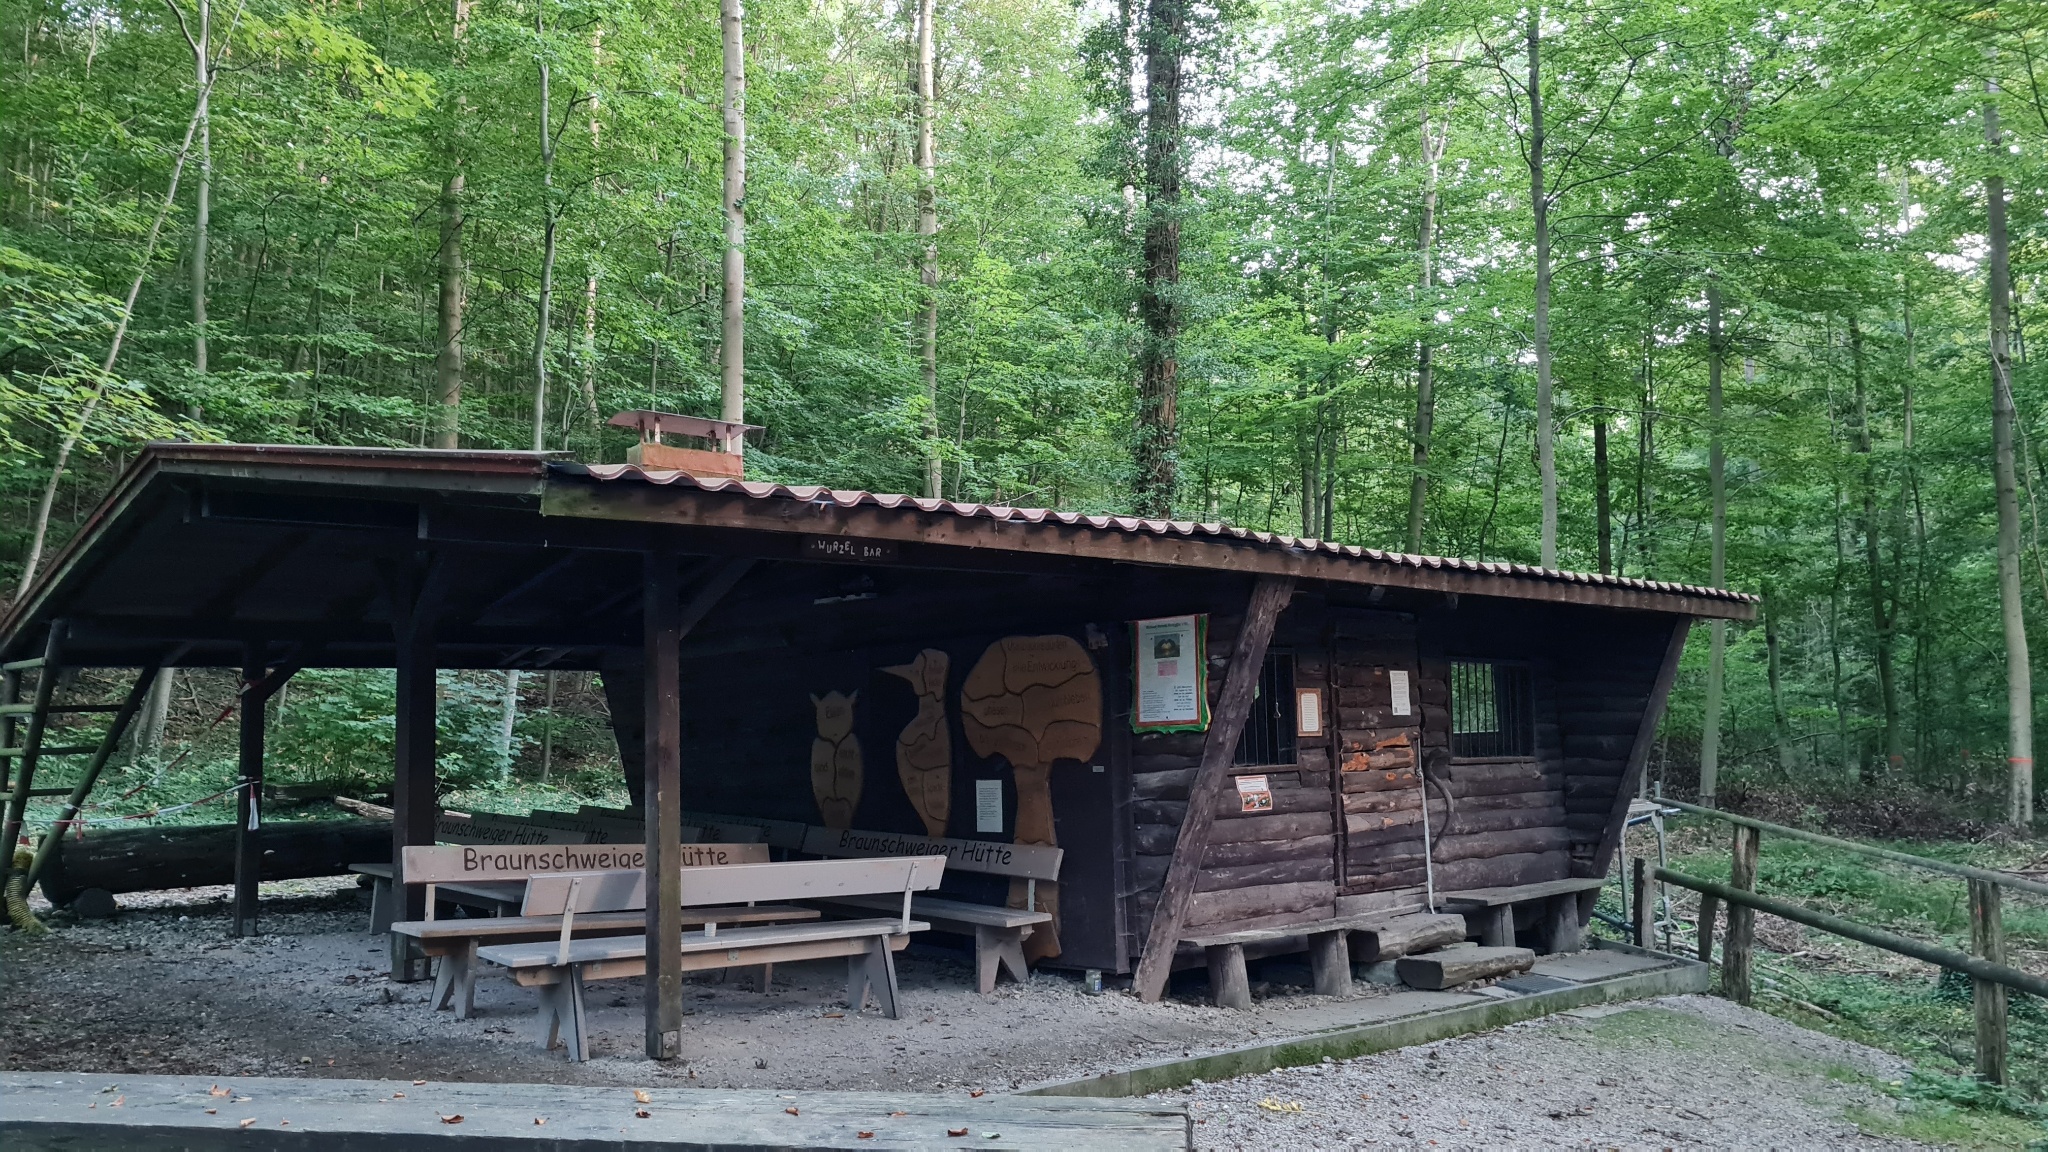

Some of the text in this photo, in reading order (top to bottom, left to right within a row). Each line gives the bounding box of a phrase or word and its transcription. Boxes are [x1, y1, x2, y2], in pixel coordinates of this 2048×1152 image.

[817, 540, 882, 558] WURZEL BAR
[463, 846, 729, 872] Braunschweige ütte
[838, 829, 1012, 866] Braunschweiger Hütte
